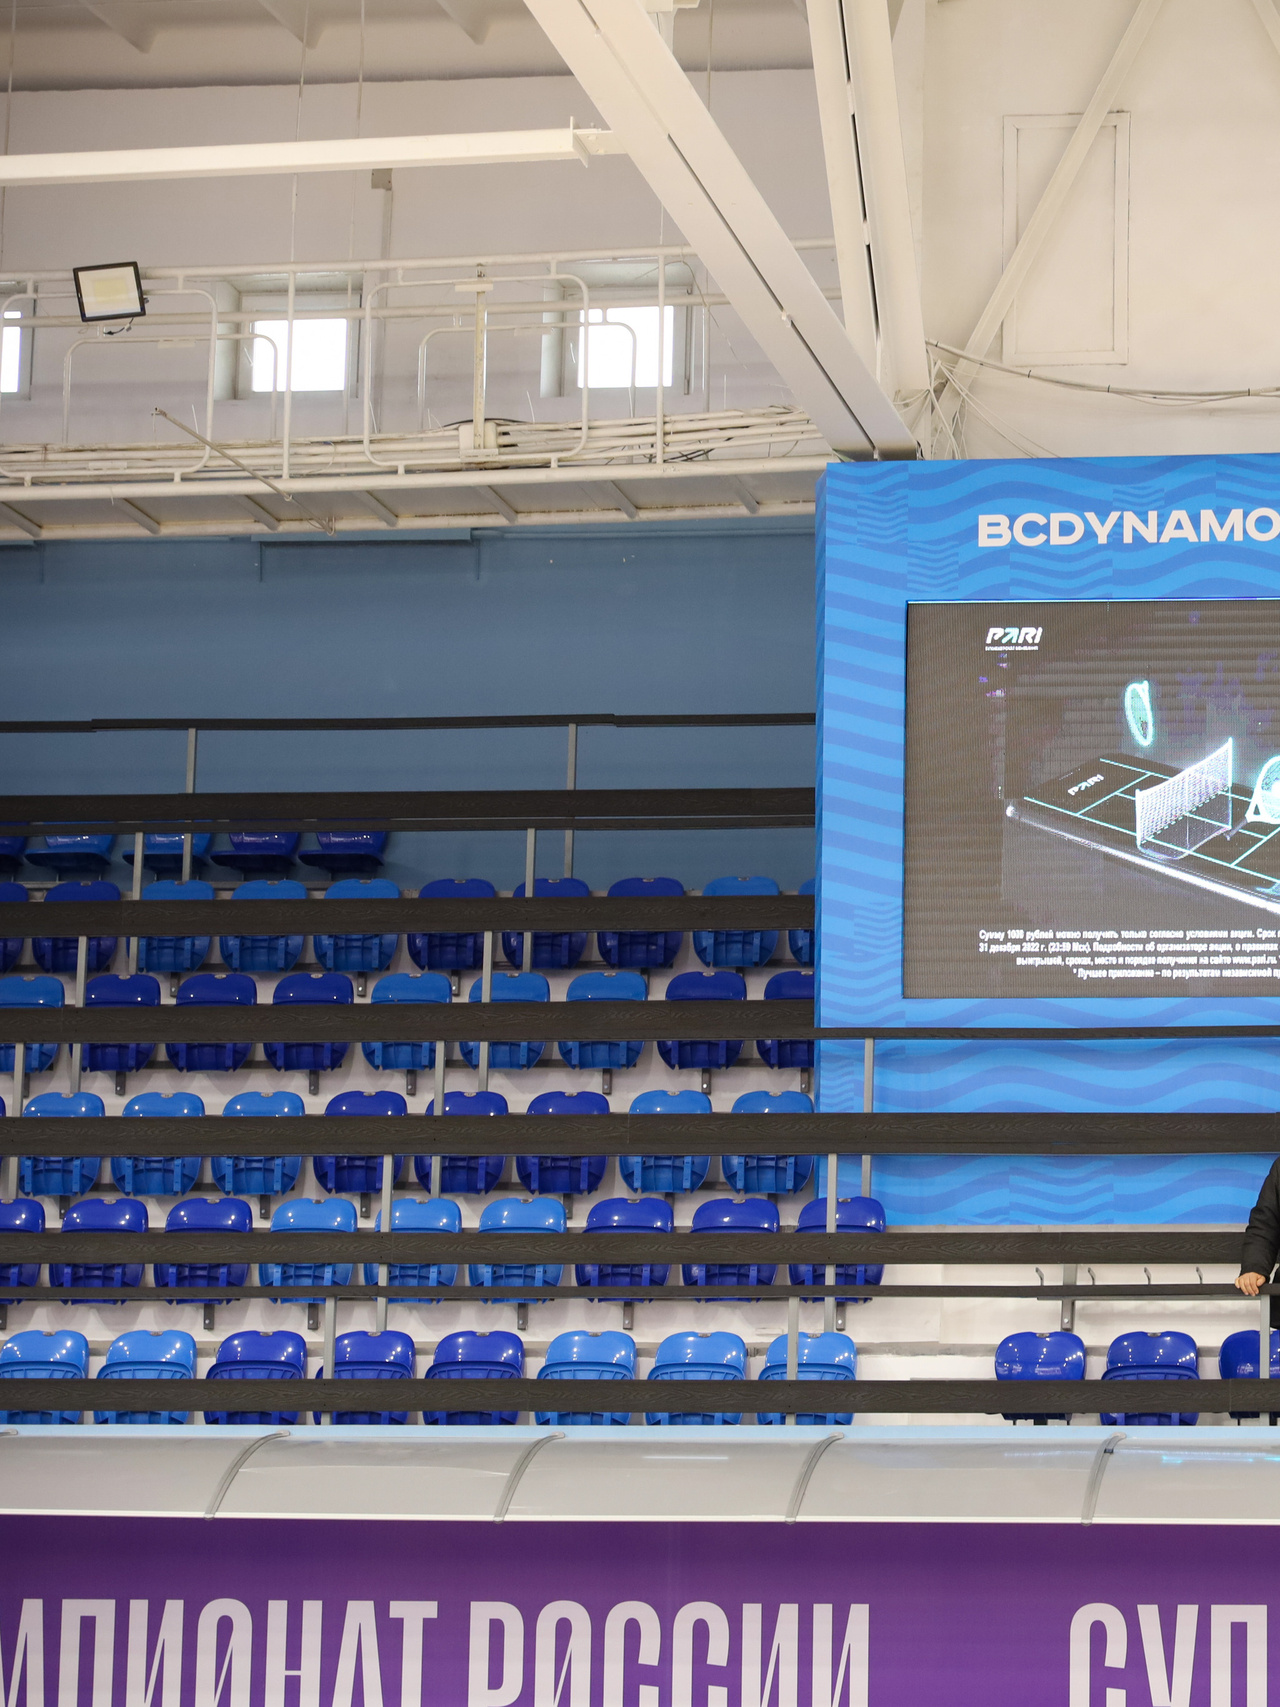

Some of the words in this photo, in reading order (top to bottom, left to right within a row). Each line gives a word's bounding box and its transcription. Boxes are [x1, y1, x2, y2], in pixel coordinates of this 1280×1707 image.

[985, 626, 1043, 644] PARI
[979, 930, 1005, 941] Сумму
[1026, 930, 1054, 941] рублей
[1083, 931, 1119, 941] получить
[1149, 930, 1184, 938] согласно
[1256, 929, 1277, 940] Срок
[979, 943, 989, 952] 31
[989, 942, 1021, 953] декабря
[1092, 942, 1144, 953] Подробности
[1145, 942, 1155, 951] об
[1156, 944, 1208, 953] организаторе
[1235, 943, 1241, 951] о
[1241, 943, 1279, 953] правилах
[1161, 969, 1172, 977] по
[1172, 969, 1221, 979] результатам
[1222, 968, 1273, 977] независимой
[467, 1600, 871, 1707] РОССИИ
